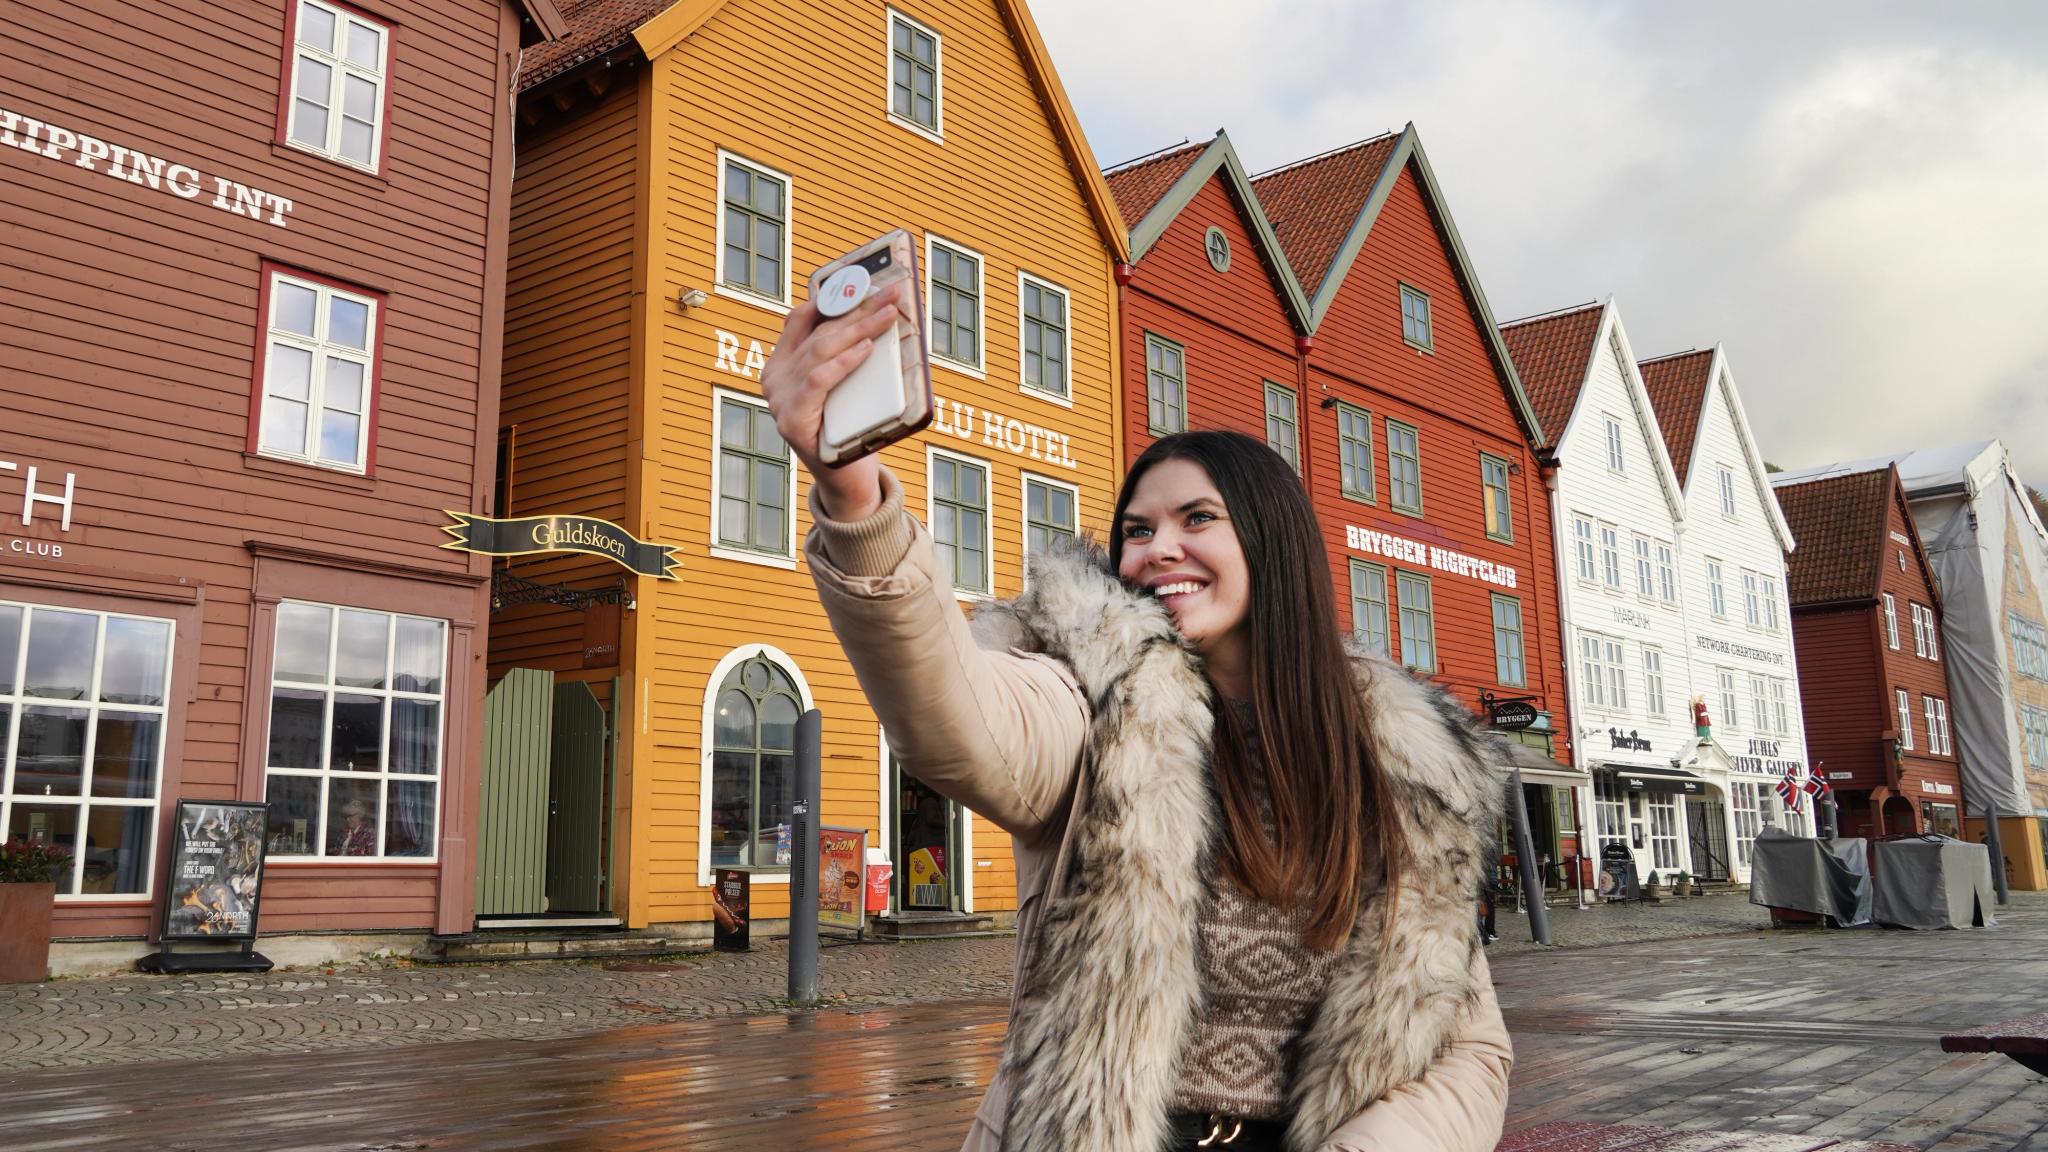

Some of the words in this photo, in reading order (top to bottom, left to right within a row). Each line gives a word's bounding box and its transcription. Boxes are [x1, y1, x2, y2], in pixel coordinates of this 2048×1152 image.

[212, 176, 293, 228] INT
[714, 329, 776, 380] RA
[930, 396, 975, 439] LU
[982, 410, 1077, 469] HOTEL
[11, 539, 63, 558] CLUB
[532, 522, 625, 558] Guldskoen
[1345, 524, 1427, 566] BRYGGEN
[1429, 546, 1517, 589] NIGHTCLUB
[1696, 635, 1730, 654] NETWORK
[1730, 643, 1772, 663] CHARTERING
[1496, 714, 1532, 724] BRYGGEN
[184, 865, 195, 874] THE
[199, 865, 215, 875] WORD
